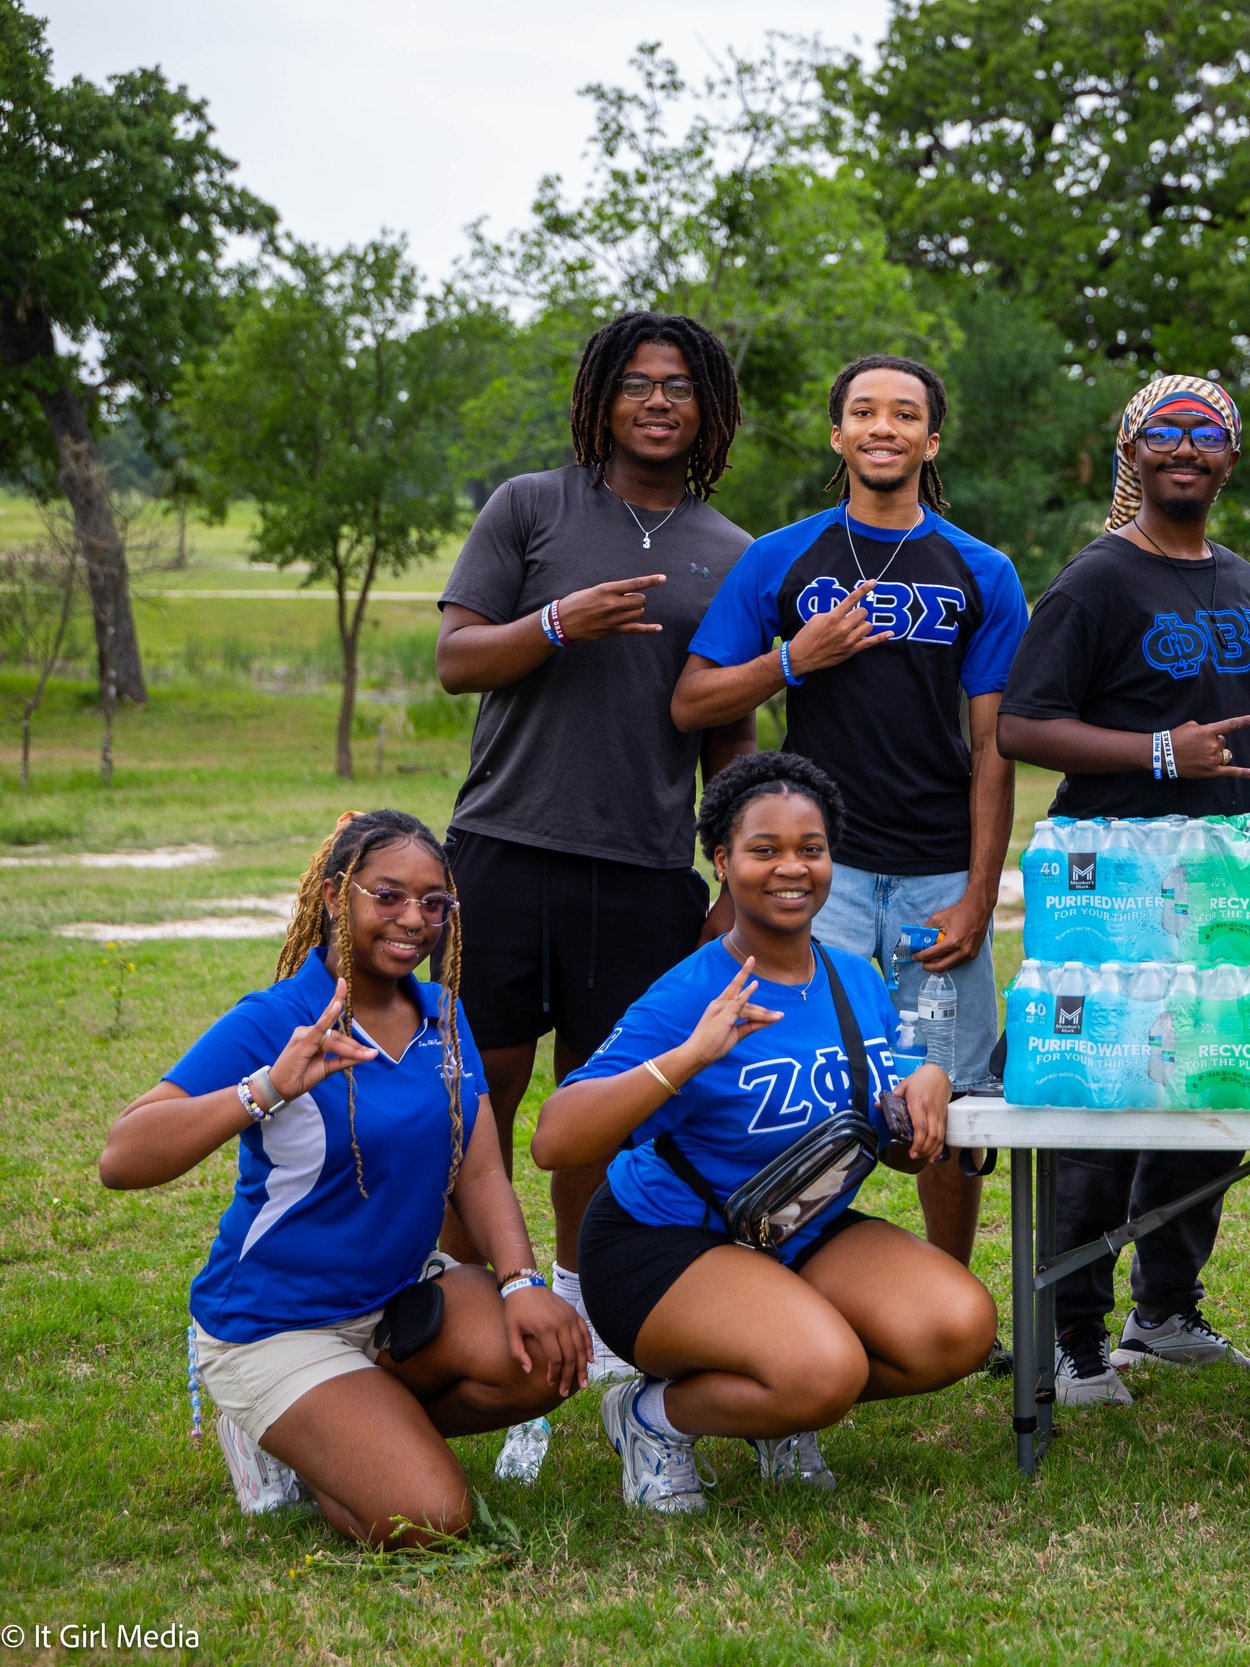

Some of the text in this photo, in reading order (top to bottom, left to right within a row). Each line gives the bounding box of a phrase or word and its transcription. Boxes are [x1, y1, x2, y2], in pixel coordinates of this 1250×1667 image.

[1162, 732, 1172, 757] TEXAS
[1040, 862, 1060, 876] 40
[1054, 908, 1154, 922] FOR YOUR THIRST
[1198, 911, 1216, 923] FOR
[1219, 910, 1243, 918] THE
[1025, 1002, 1046, 1016] 40
[1036, 1052, 1139, 1069] FOR YOUR THIRST
[1185, 1060, 1207, 1070] FOR
[1211, 1058, 1236, 1066] THE
